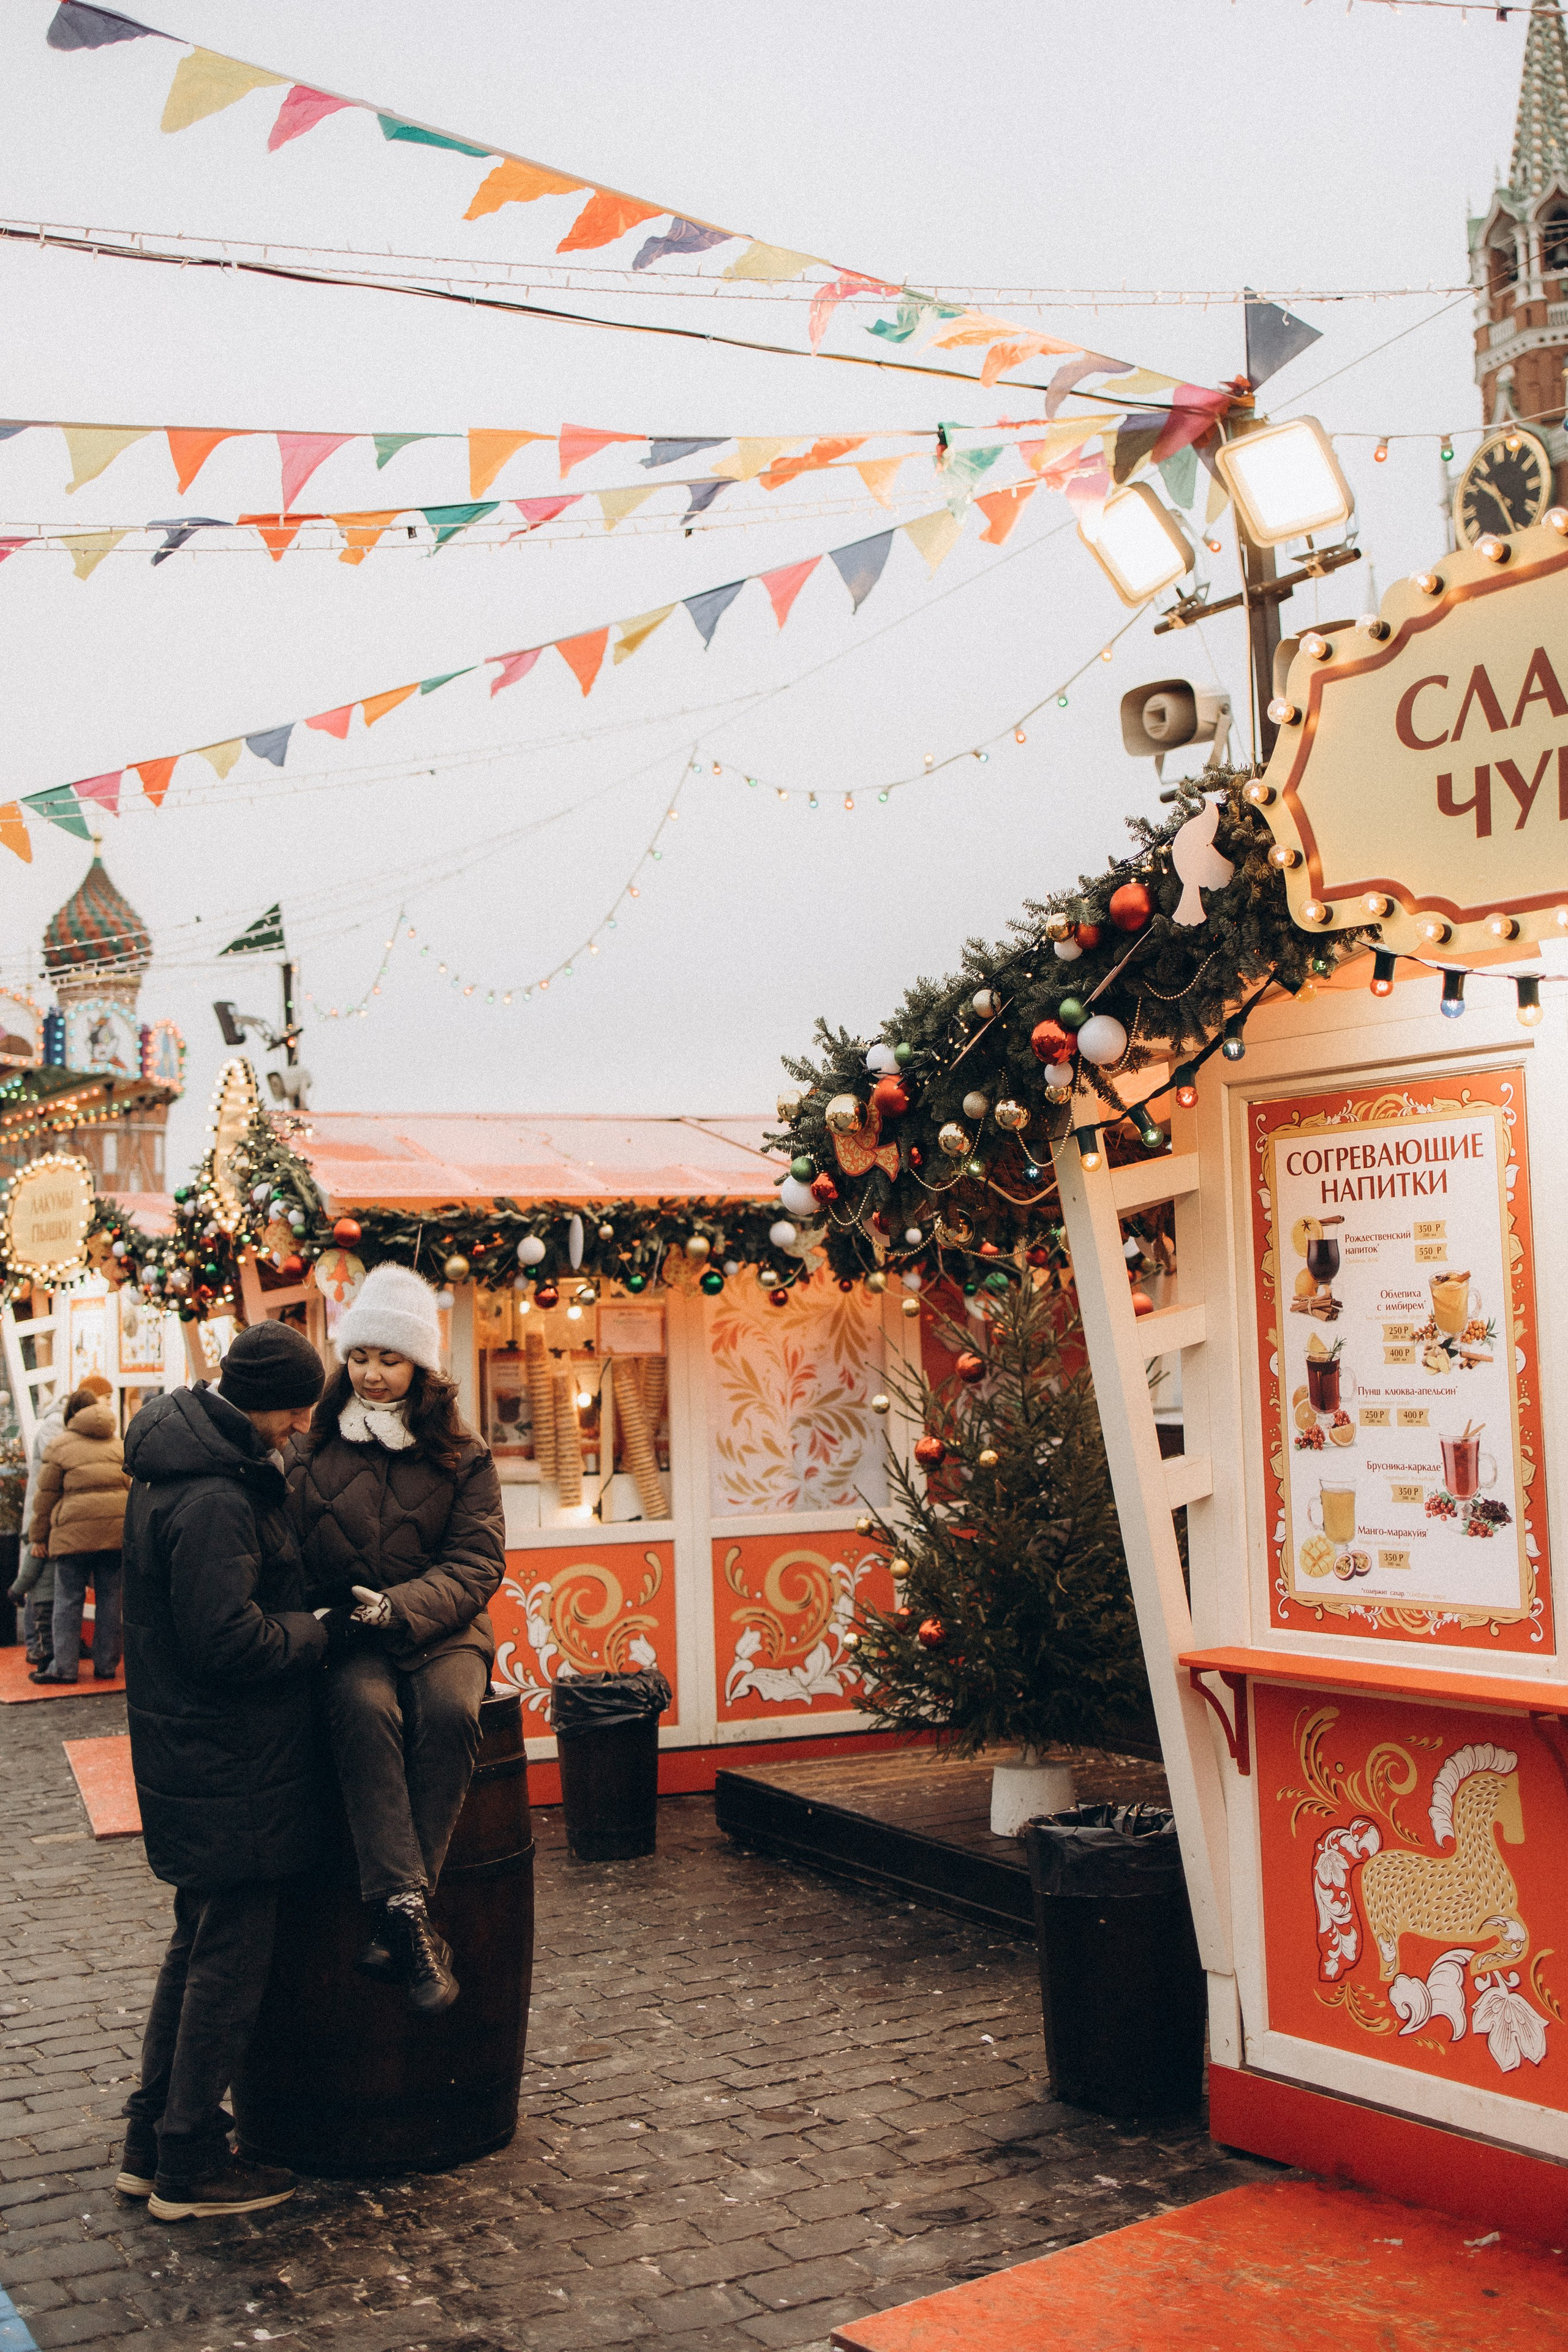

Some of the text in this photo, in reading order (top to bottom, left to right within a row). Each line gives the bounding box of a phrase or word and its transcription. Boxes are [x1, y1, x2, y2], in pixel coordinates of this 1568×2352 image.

[1286, 1133, 1483, 1176] СОГРЕВАЮЩИЕ
[1321, 1169, 1447, 1204] НАПИТКИ
[1419, 1224, 1431, 1233] 350
[1345, 1231, 1411, 1243] Рождественский
[1380, 1289, 1421, 1299] Облепиха
[1358, 1387, 1381, 1398] Пунш
[1398, 1487, 1412, 1496] 350
